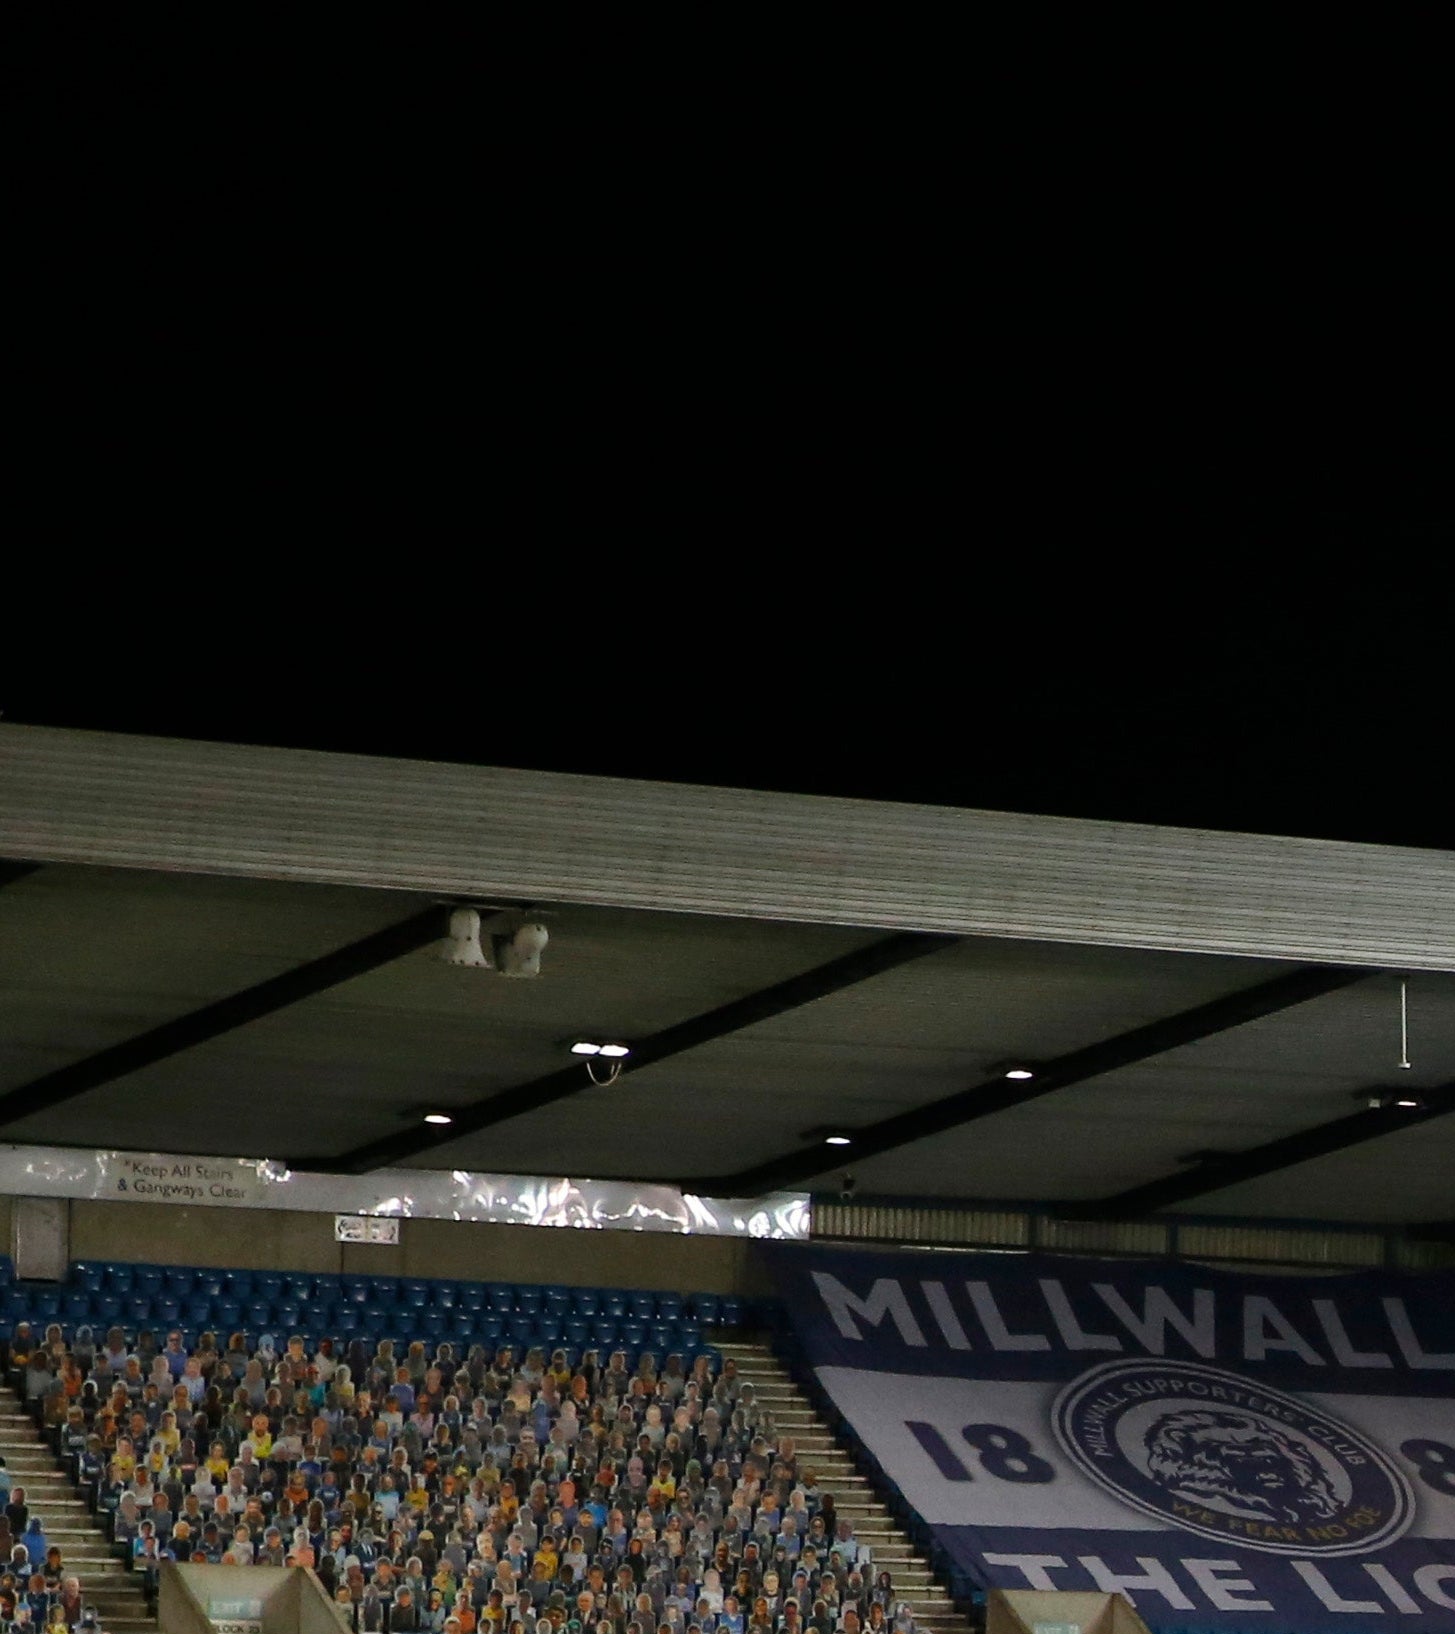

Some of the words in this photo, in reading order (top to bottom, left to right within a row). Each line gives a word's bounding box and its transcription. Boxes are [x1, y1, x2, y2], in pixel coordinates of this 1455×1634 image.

[171, 1163, 191, 1178] All
[903, 1419, 1059, 1486] 18
[1306, 1424, 1368, 1467] CLUB
[1171, 1501, 1215, 1525] WE
[1229, 1517, 1301, 1541] FEAR
[1305, 1524, 1347, 1542] NO
[979, 1551, 1274, 1614] THE
